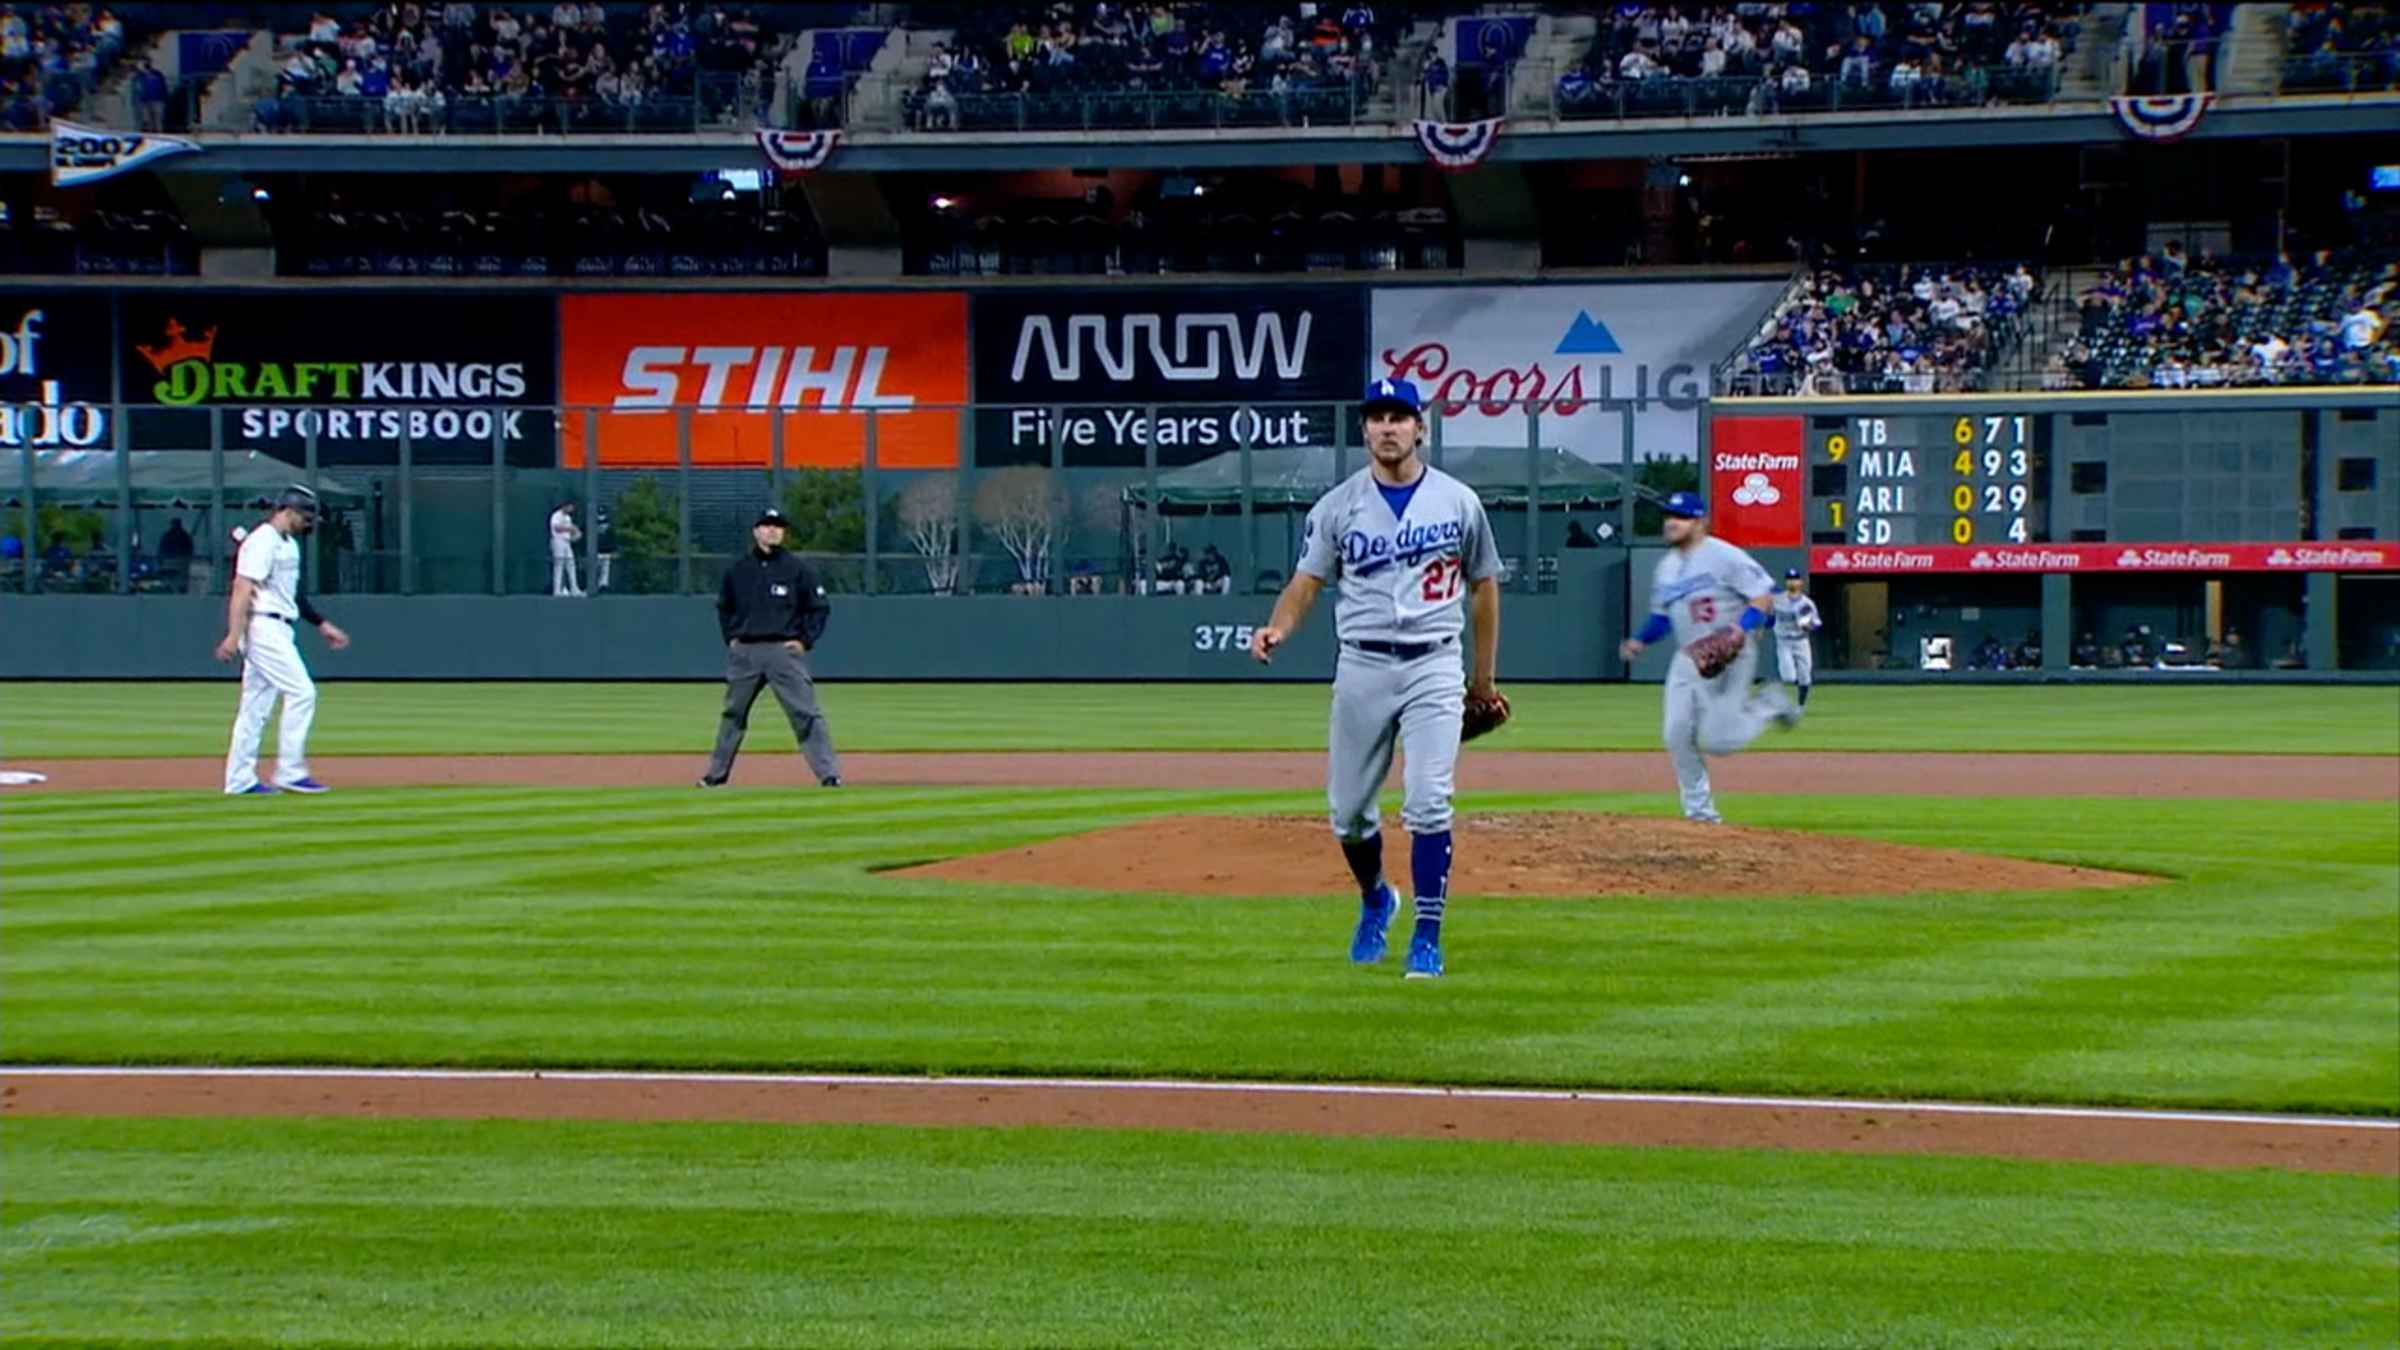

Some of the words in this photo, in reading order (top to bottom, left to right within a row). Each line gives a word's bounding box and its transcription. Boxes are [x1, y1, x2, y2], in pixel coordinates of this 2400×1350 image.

[56, 133, 144, 156] 2007
[1011, 311, 1312, 381] ARROW
[154, 359, 526, 405] DRAFTKINGS
[611, 346, 915, 413] STIHL
[1382, 342, 1590, 417] Coors
[242, 407, 524, 440] SPORTSBOOK
[1011, 409, 1097, 446] Five
[1104, 409, 1219, 446] Years
[1229, 408, 1309, 446] Out
[1857, 419, 1887, 446] TB
[1953, 417, 1974, 444] 6
[1827, 435, 1847, 462] 9
[1859, 451, 1915, 477] MIA
[1954, 451, 1973, 475] 4
[1857, 486, 1903, 513] ARI
[1953, 485, 1972, 512] 0
[1830, 502, 1843, 528] 1
[1341, 518, 1463, 568] Dodgers
[1856, 518, 1891, 544] SD
[1953, 518, 1972, 544] 0
[2008, 518, 2027, 543] 4
[1422, 557, 1461, 602] 27
[1195, 625, 1253, 650] 375
